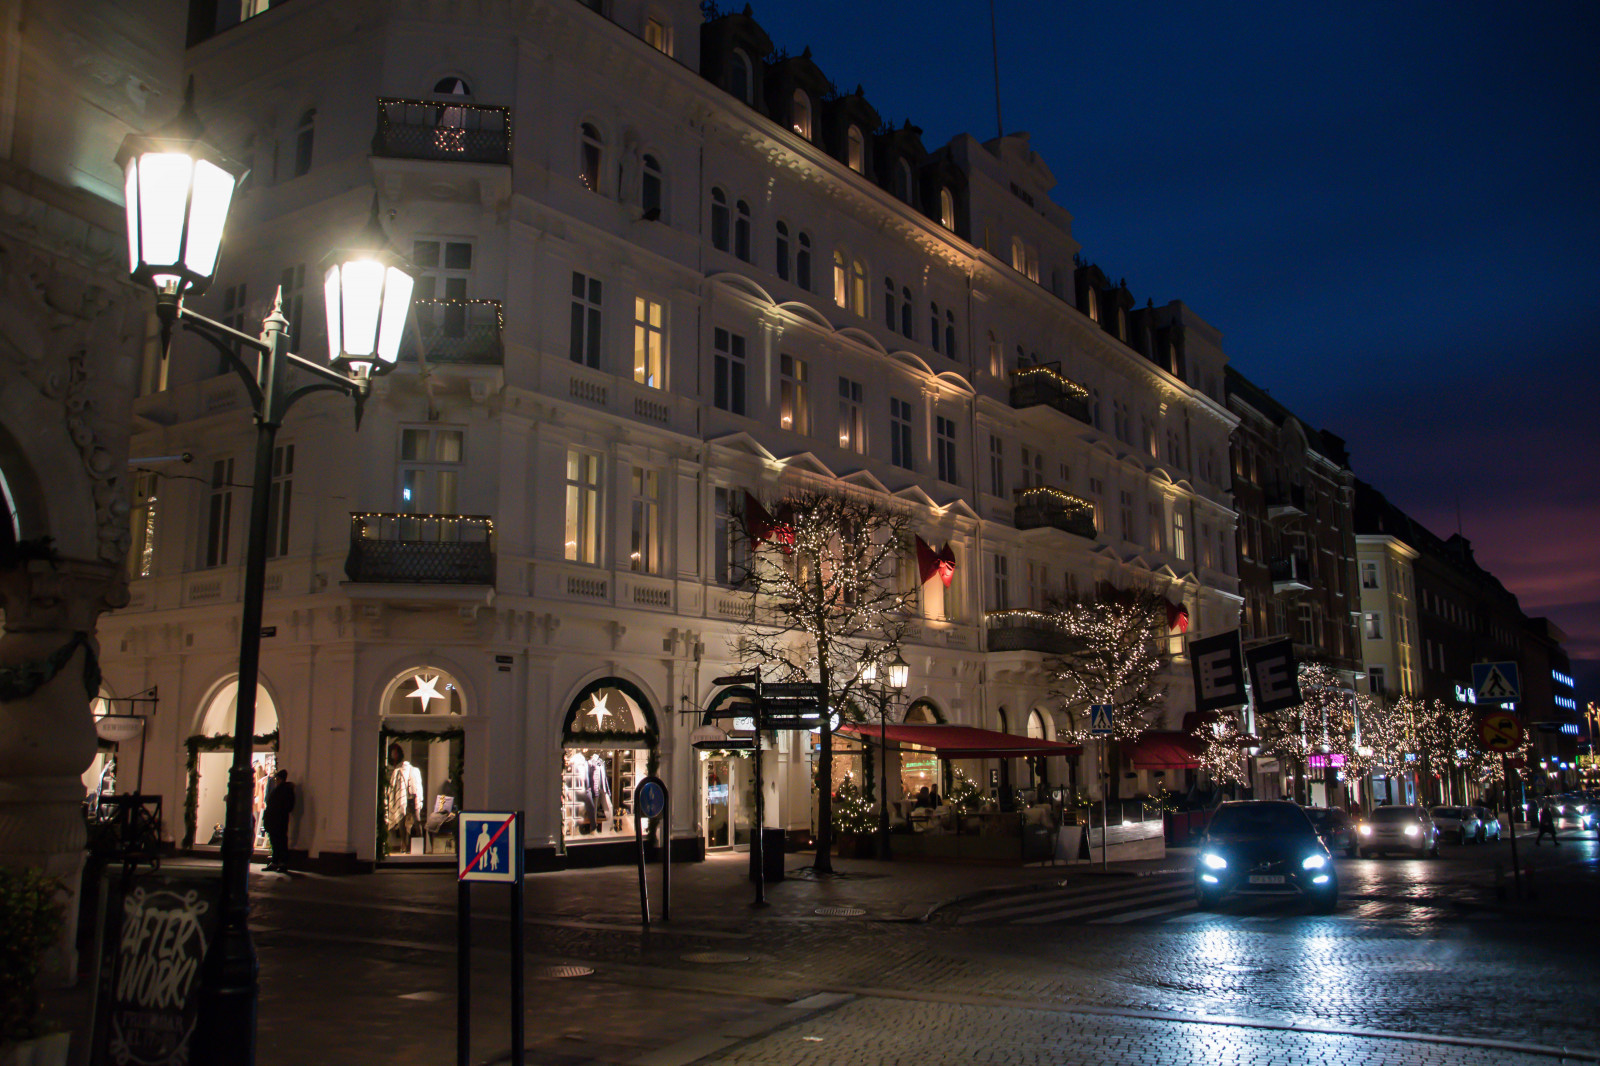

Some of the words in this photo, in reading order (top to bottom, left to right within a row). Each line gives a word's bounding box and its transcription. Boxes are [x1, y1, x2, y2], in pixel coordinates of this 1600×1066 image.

[1199, 648, 1237, 700] E
[1256, 656, 1294, 702] E
[120, 906, 197, 961] AFTER
